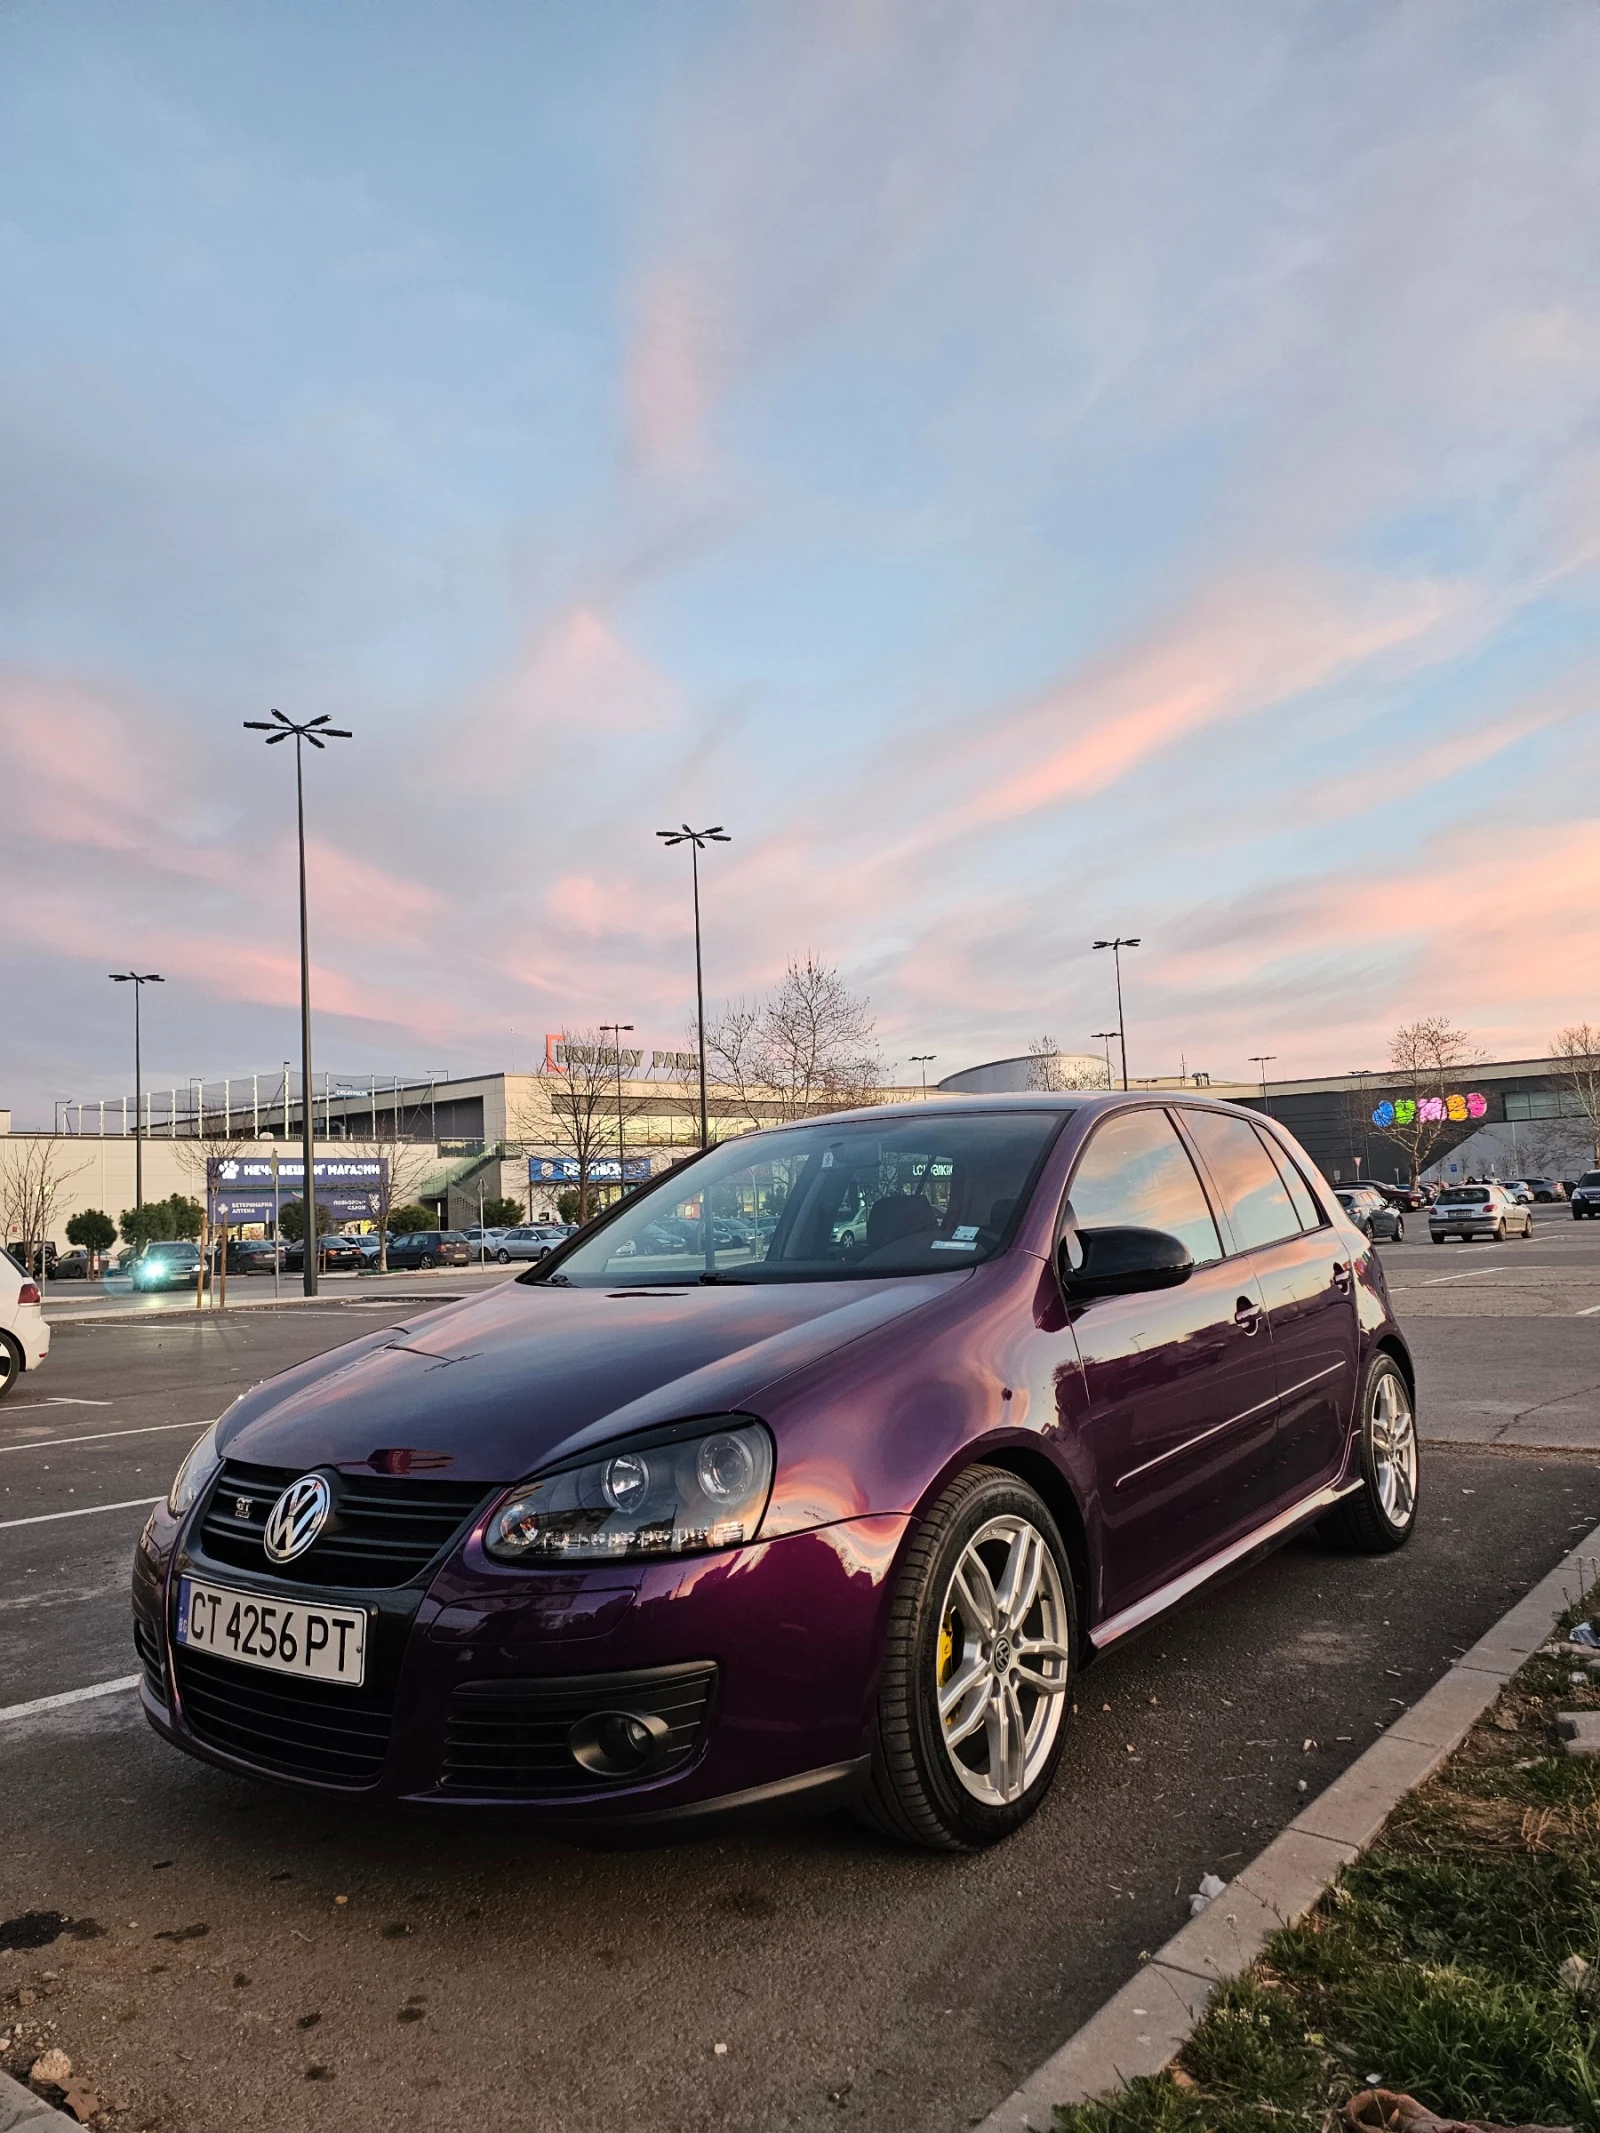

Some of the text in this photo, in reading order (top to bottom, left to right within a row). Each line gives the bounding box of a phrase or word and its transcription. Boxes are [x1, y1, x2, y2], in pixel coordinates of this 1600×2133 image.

[556, 1044, 701, 1070] HOLIDAY PARK
[1372, 1093, 1487, 1127] JUMBO
[244, 1164, 380, 1175] НЕЧВЕШИ МАГАЗИН
[236, 1498, 253, 1511] GT
[178, 1592, 355, 1672] BG CT 4256 PT
